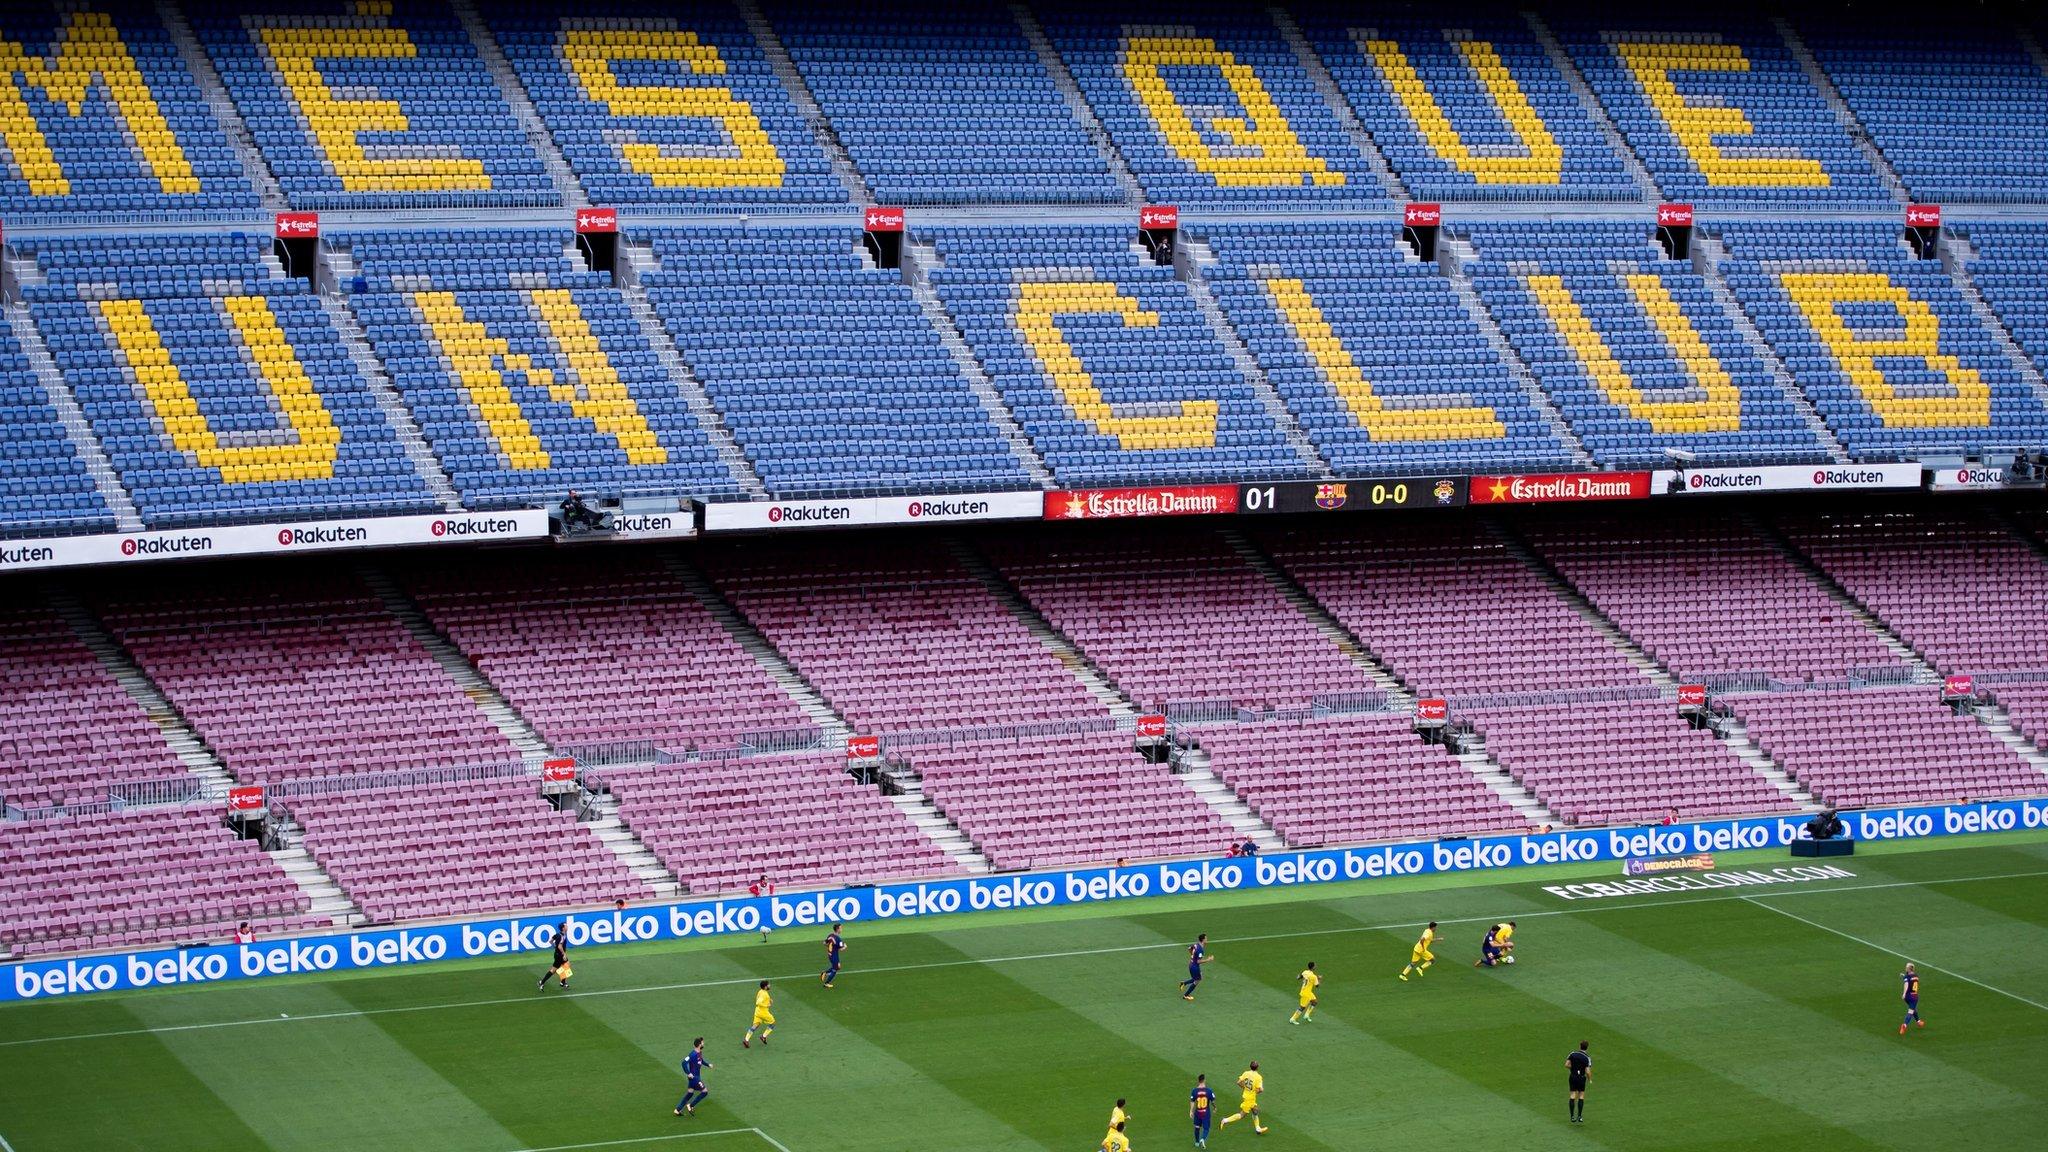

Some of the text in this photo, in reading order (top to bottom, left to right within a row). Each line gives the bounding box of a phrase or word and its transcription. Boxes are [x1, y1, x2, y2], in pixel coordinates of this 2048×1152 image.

[1124, 38, 1830, 187] QUE
[100, 273, 1990, 483] UN CLUB
[1703, 474, 1762, 488] Rakuten
[1826, 470, 1884, 484] Rakuten
[1970, 470, 2003, 483] Raku
[1245, 484, 1408, 509] 01 0-0
[1511, 478, 1631, 500] Estrella Damm
[783, 506, 850, 521] Rakuten
[923, 501, 989, 516] Rakuten
[1088, 492, 1218, 516] Estrella Damm
[612, 515, 671, 532] akuten
[137, 537, 212, 554] Rakuten
[294, 527, 367, 544] Rakuten
[447, 519, 517, 535] Rakuten
[1542, 865, 1857, 900] FCBARCELONA.COM
[16, 961, 117, 997] beko
[128, 951, 227, 986] beko
[240, 941, 337, 975] beko
[351, 931, 446, 965] beko
[463, 921, 556, 955] beko
[564, 912, 658, 945] beko
[670, 903, 759, 936] beko
[772, 893, 860, 926] beko
[875, 885, 960, 917] beko
[970, 878, 1055, 909] beko
[1066, 870, 1149, 901] beko
[1161, 862, 1242, 893] beko
[1254, 855, 1336, 885] beko
[1345, 848, 1423, 878] beko
[1434, 840, 1511, 870] beko
[1522, 834, 1598, 863] beko
[1610, 828, 1686, 857] beko
[1694, 822, 1768, 851] beko
[1861, 811, 1932, 839] beko
[1945, 805, 2015, 833] beko
[1196, 1096, 1208, 1109] 10
